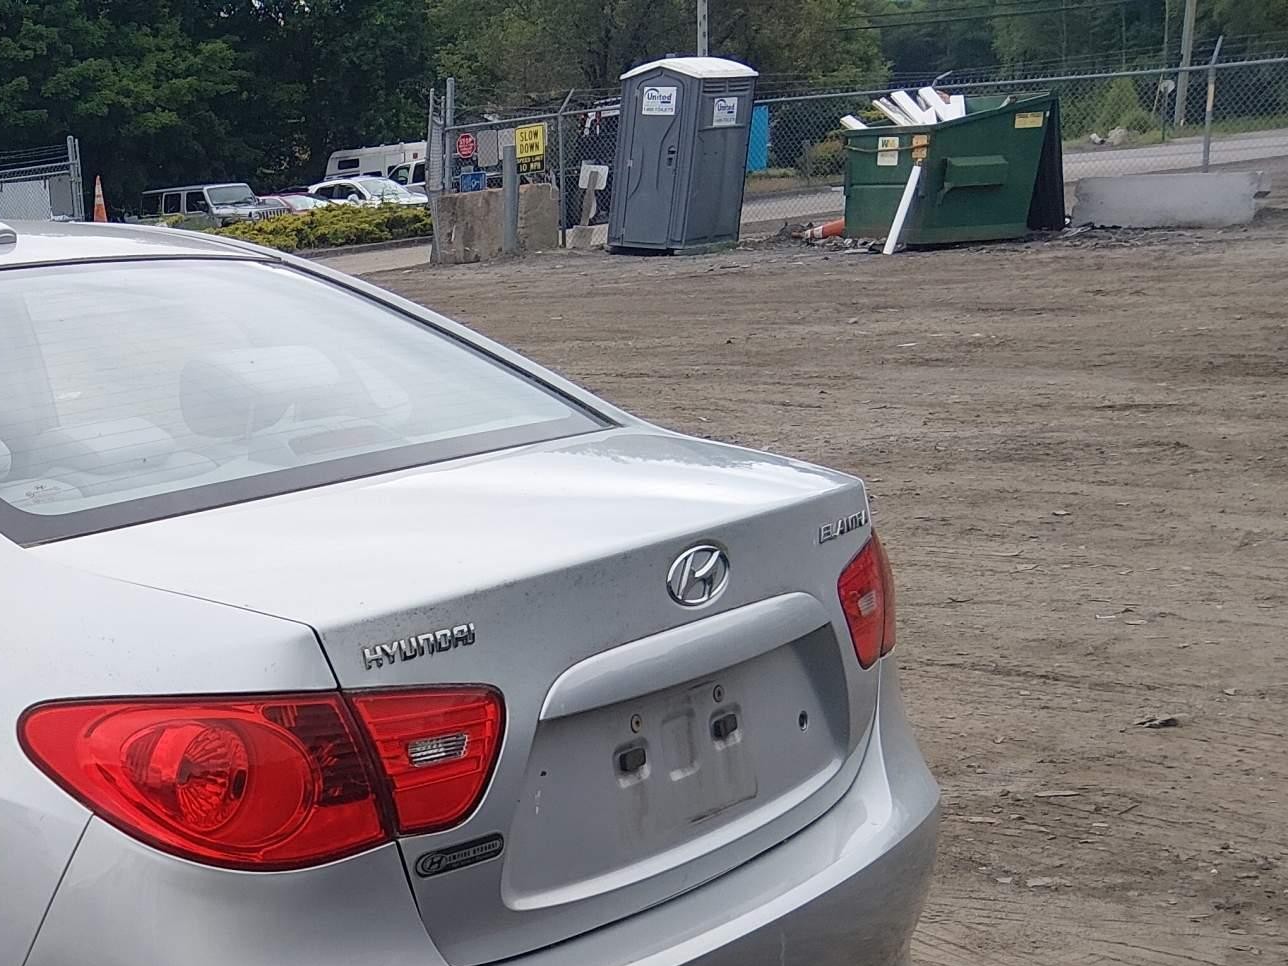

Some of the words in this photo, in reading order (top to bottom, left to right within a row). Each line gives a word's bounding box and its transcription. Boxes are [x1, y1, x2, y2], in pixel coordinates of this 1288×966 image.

[647, 92, 672, 101] United
[519, 131, 539, 142] SLOW
[519, 142, 540, 154] DOWN
[519, 163, 528, 172] 10
[362, 622, 476, 671] HYUNDAI
